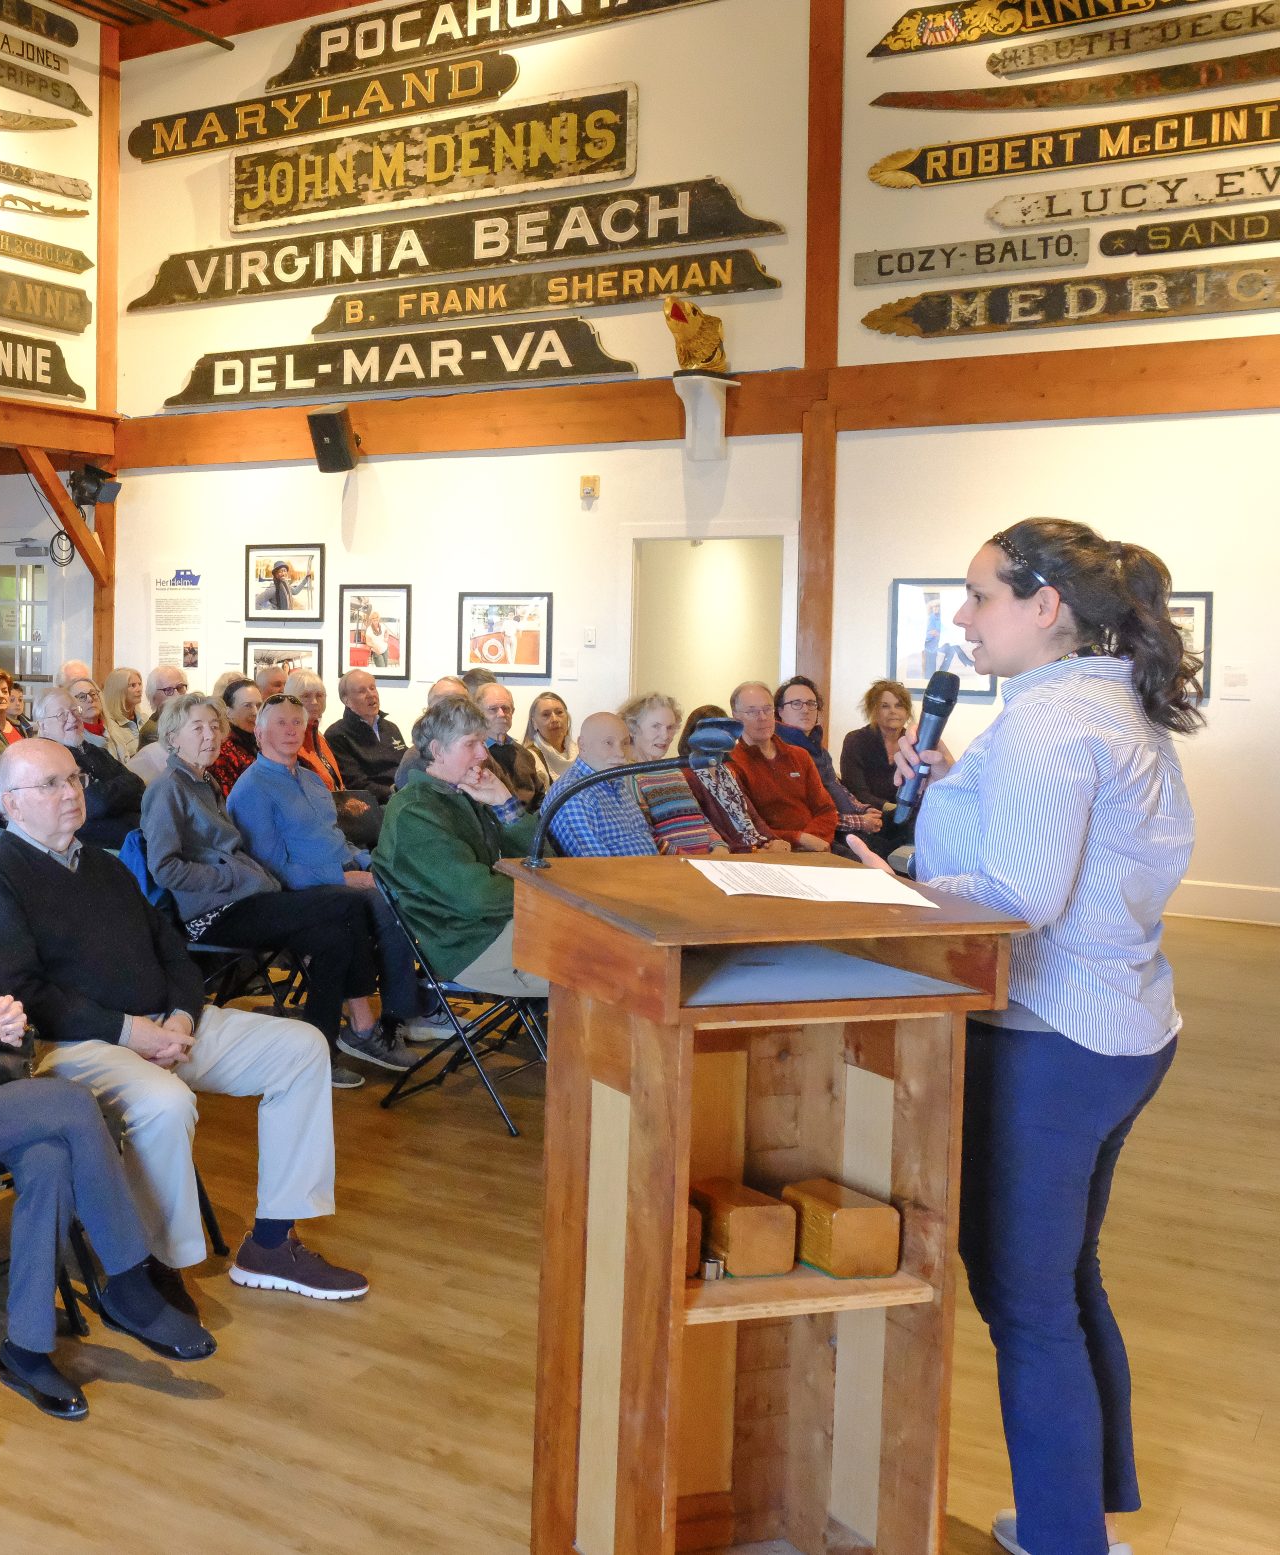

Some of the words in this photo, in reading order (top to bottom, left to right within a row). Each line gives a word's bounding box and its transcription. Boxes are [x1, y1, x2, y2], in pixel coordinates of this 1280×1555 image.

[320, 0, 623, 68] POCAHON
[1023, 0, 1147, 27] AN
[1027, 28, 1131, 65] RUTH
[152, 60, 483, 155] MARYLAND
[243, 152, 355, 210] JOHN
[426, 109, 617, 182] DENNIS
[925, 131, 1081, 180] ROBERT
[1099, 104, 1279, 158] McCLINT
[185, 229, 429, 293] VIRGINIA
[473, 191, 691, 259] BEACH
[1148, 215, 1270, 250] SAND
[2, 283, 81, 322] ANNE
[346, 299, 375, 324] B.
[398, 283, 507, 319] FRANK
[546, 257, 735, 302] SHERMAN
[213, 329, 573, 396] DEL-MAR-VA
[155, 578, 168, 586] Her
